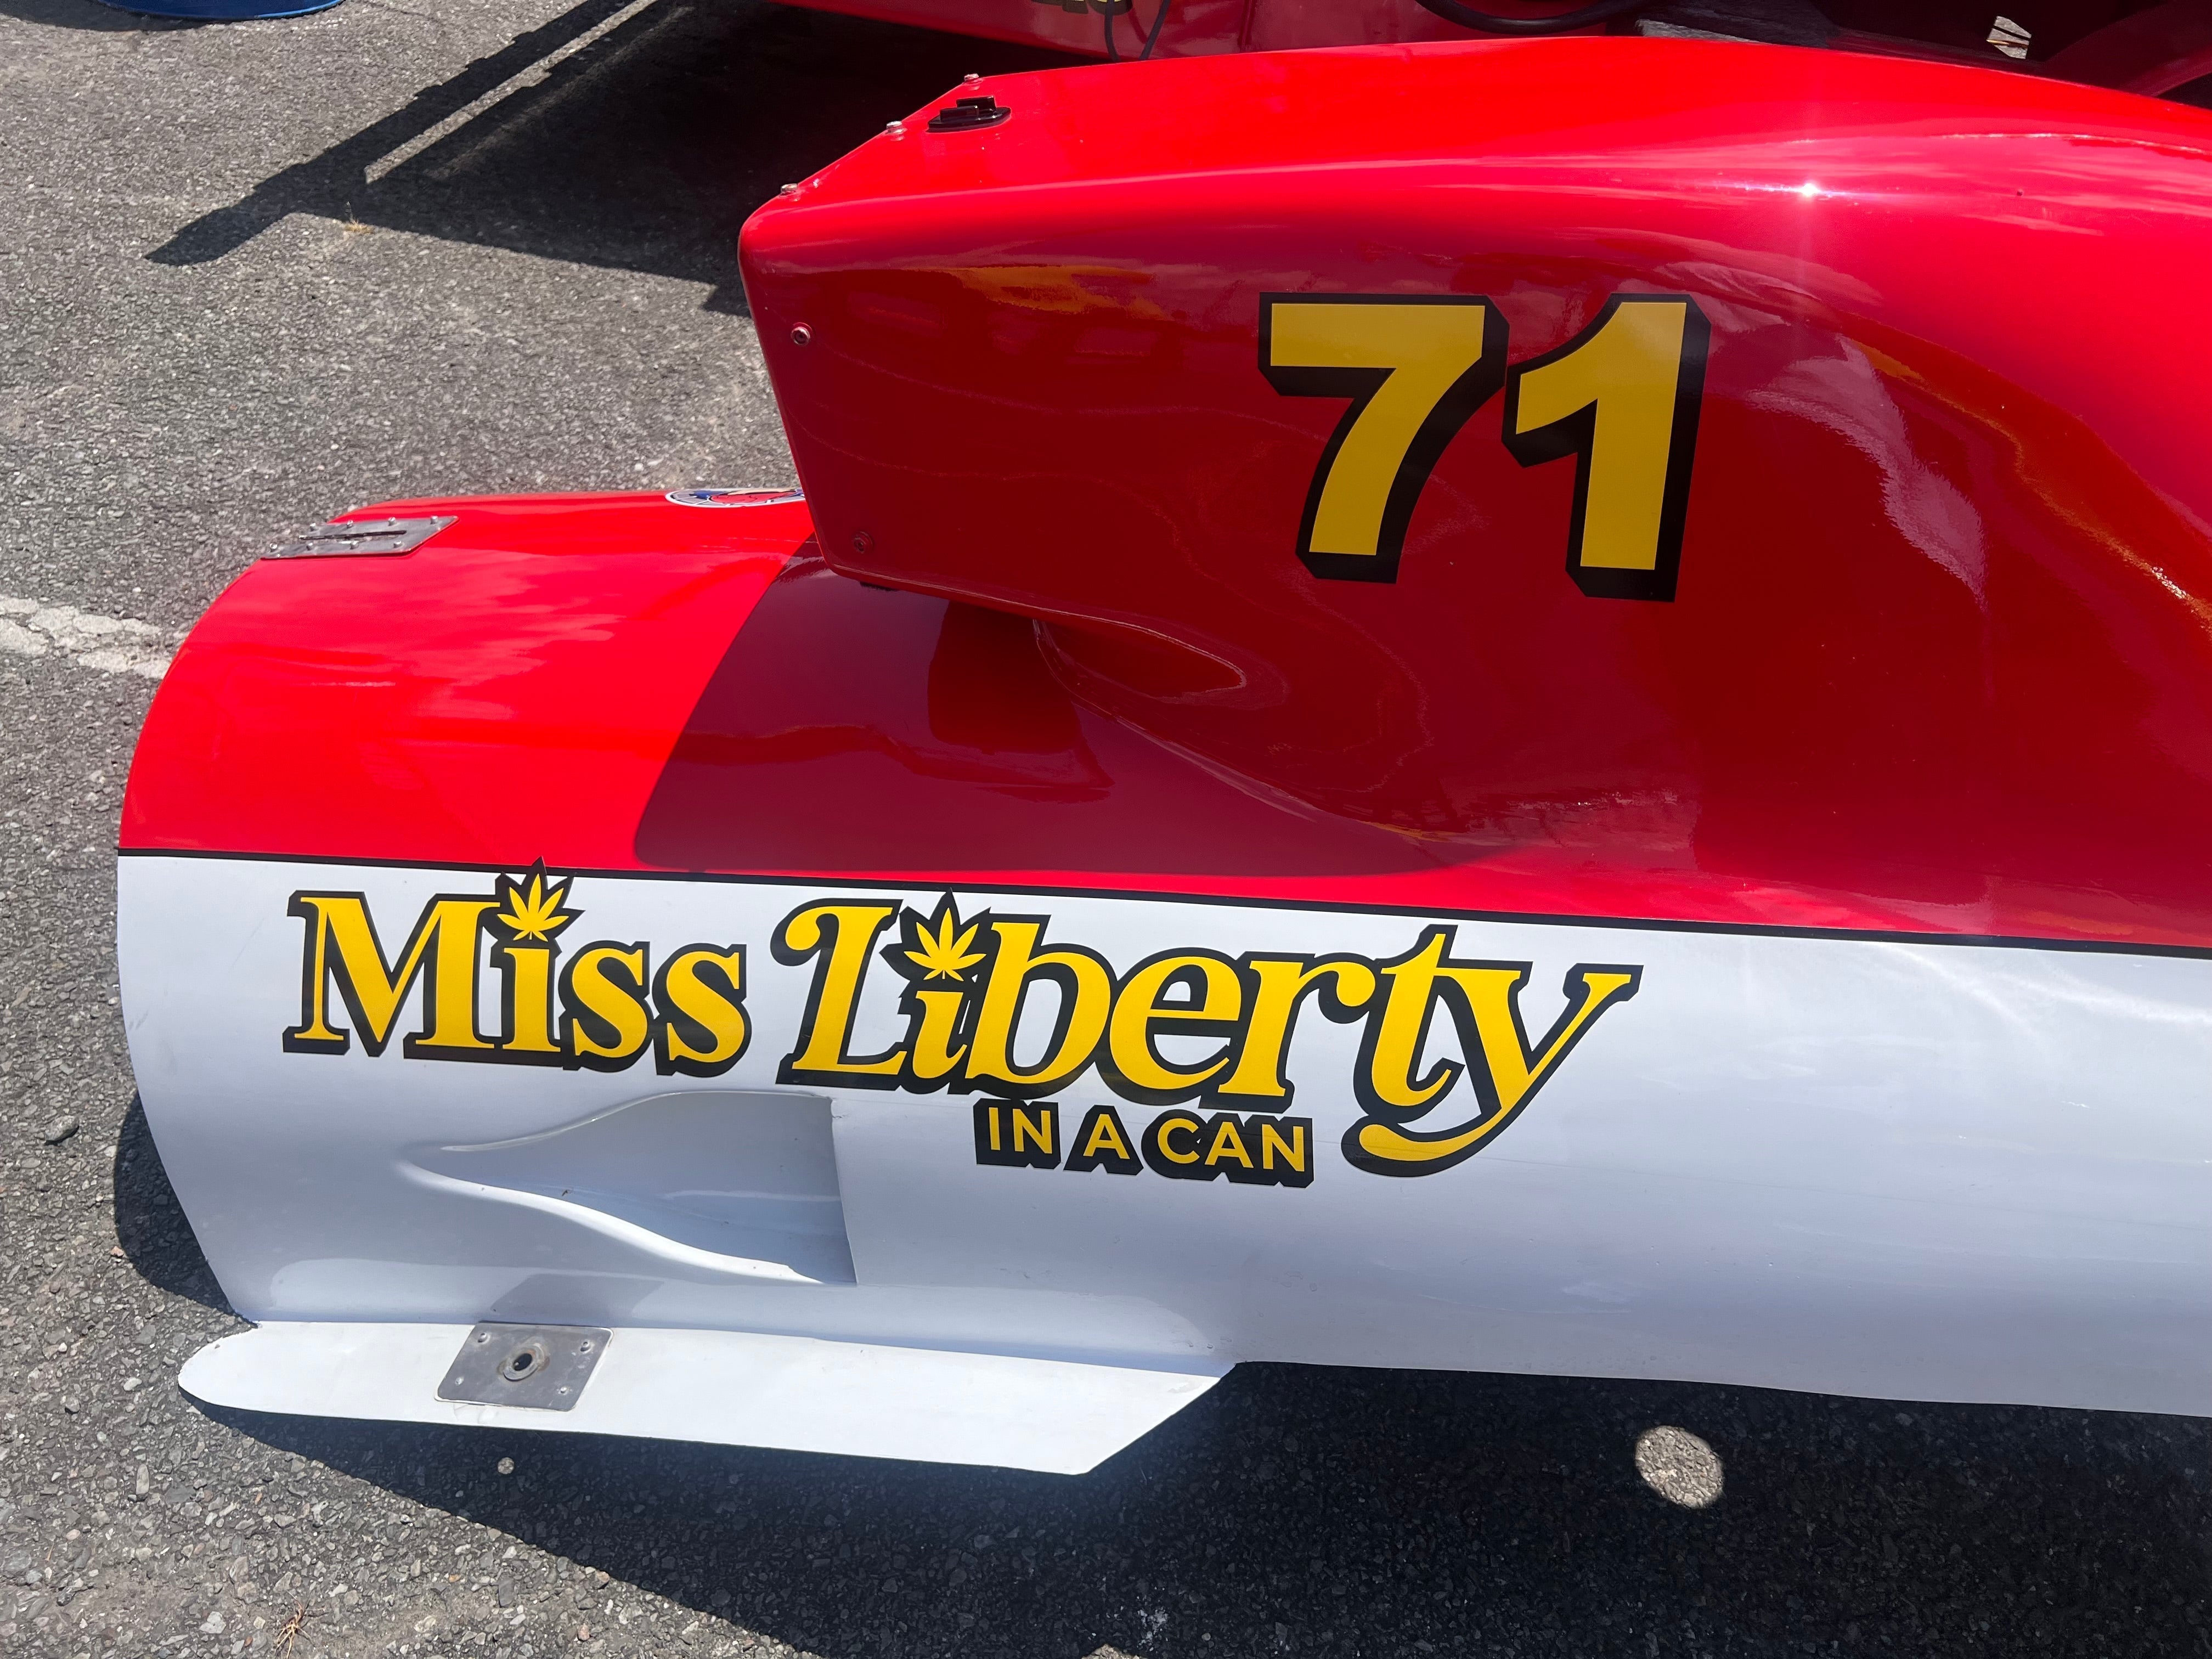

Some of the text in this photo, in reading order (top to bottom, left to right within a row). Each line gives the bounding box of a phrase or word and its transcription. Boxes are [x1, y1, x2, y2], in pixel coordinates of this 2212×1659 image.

[1259, 292, 1711, 602] 71
[283, 857, 1643, 1177] Miss Liberty
[974, 1098, 1314, 1188] IN A CAN
